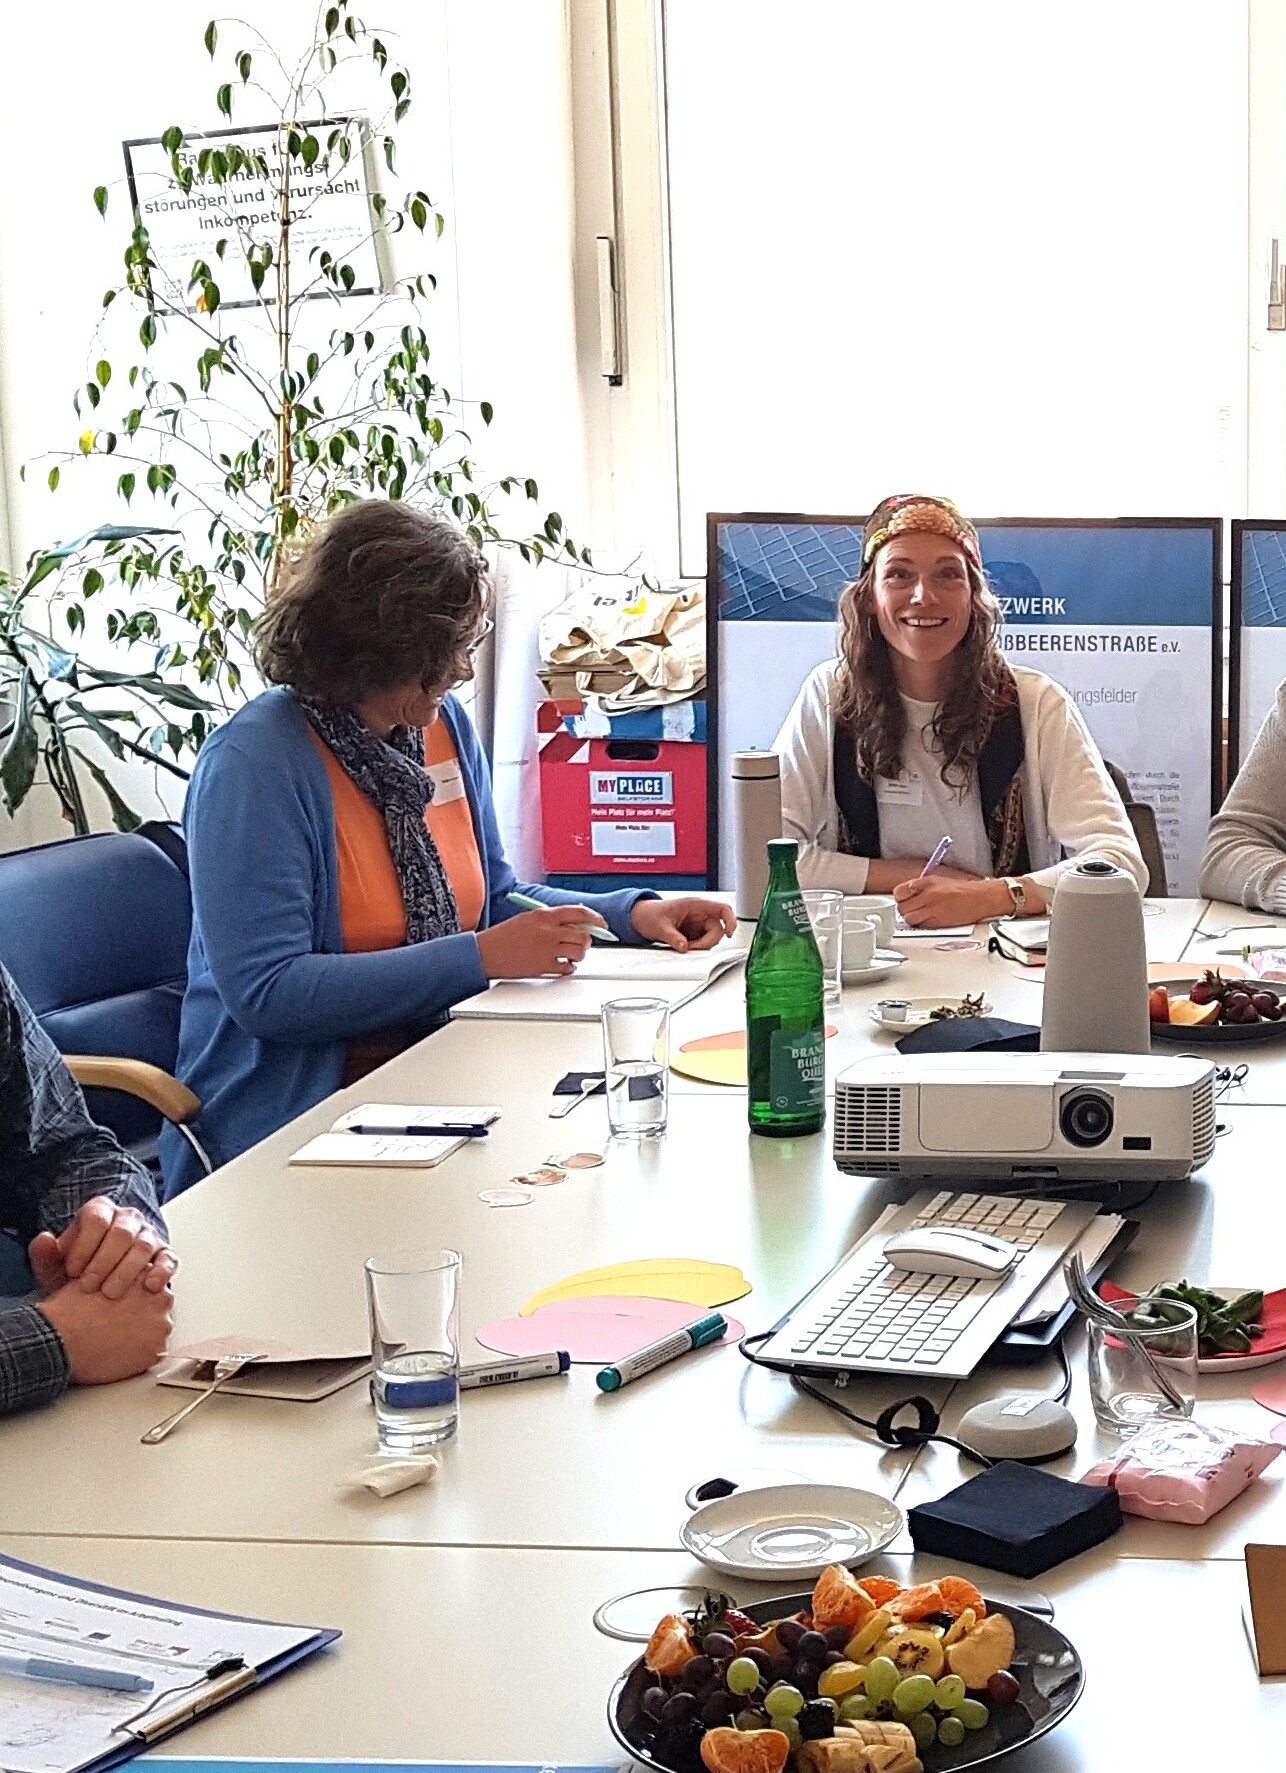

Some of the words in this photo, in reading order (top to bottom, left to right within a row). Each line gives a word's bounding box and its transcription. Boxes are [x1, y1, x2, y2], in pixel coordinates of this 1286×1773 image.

[145, 195, 228, 213] störungen
[233, 187, 265, 204] und
[270, 179, 361, 199] vrursacht
[198, 209, 313, 230] Inkompetnz.
[1001, 597, 1066, 615] ZWERK
